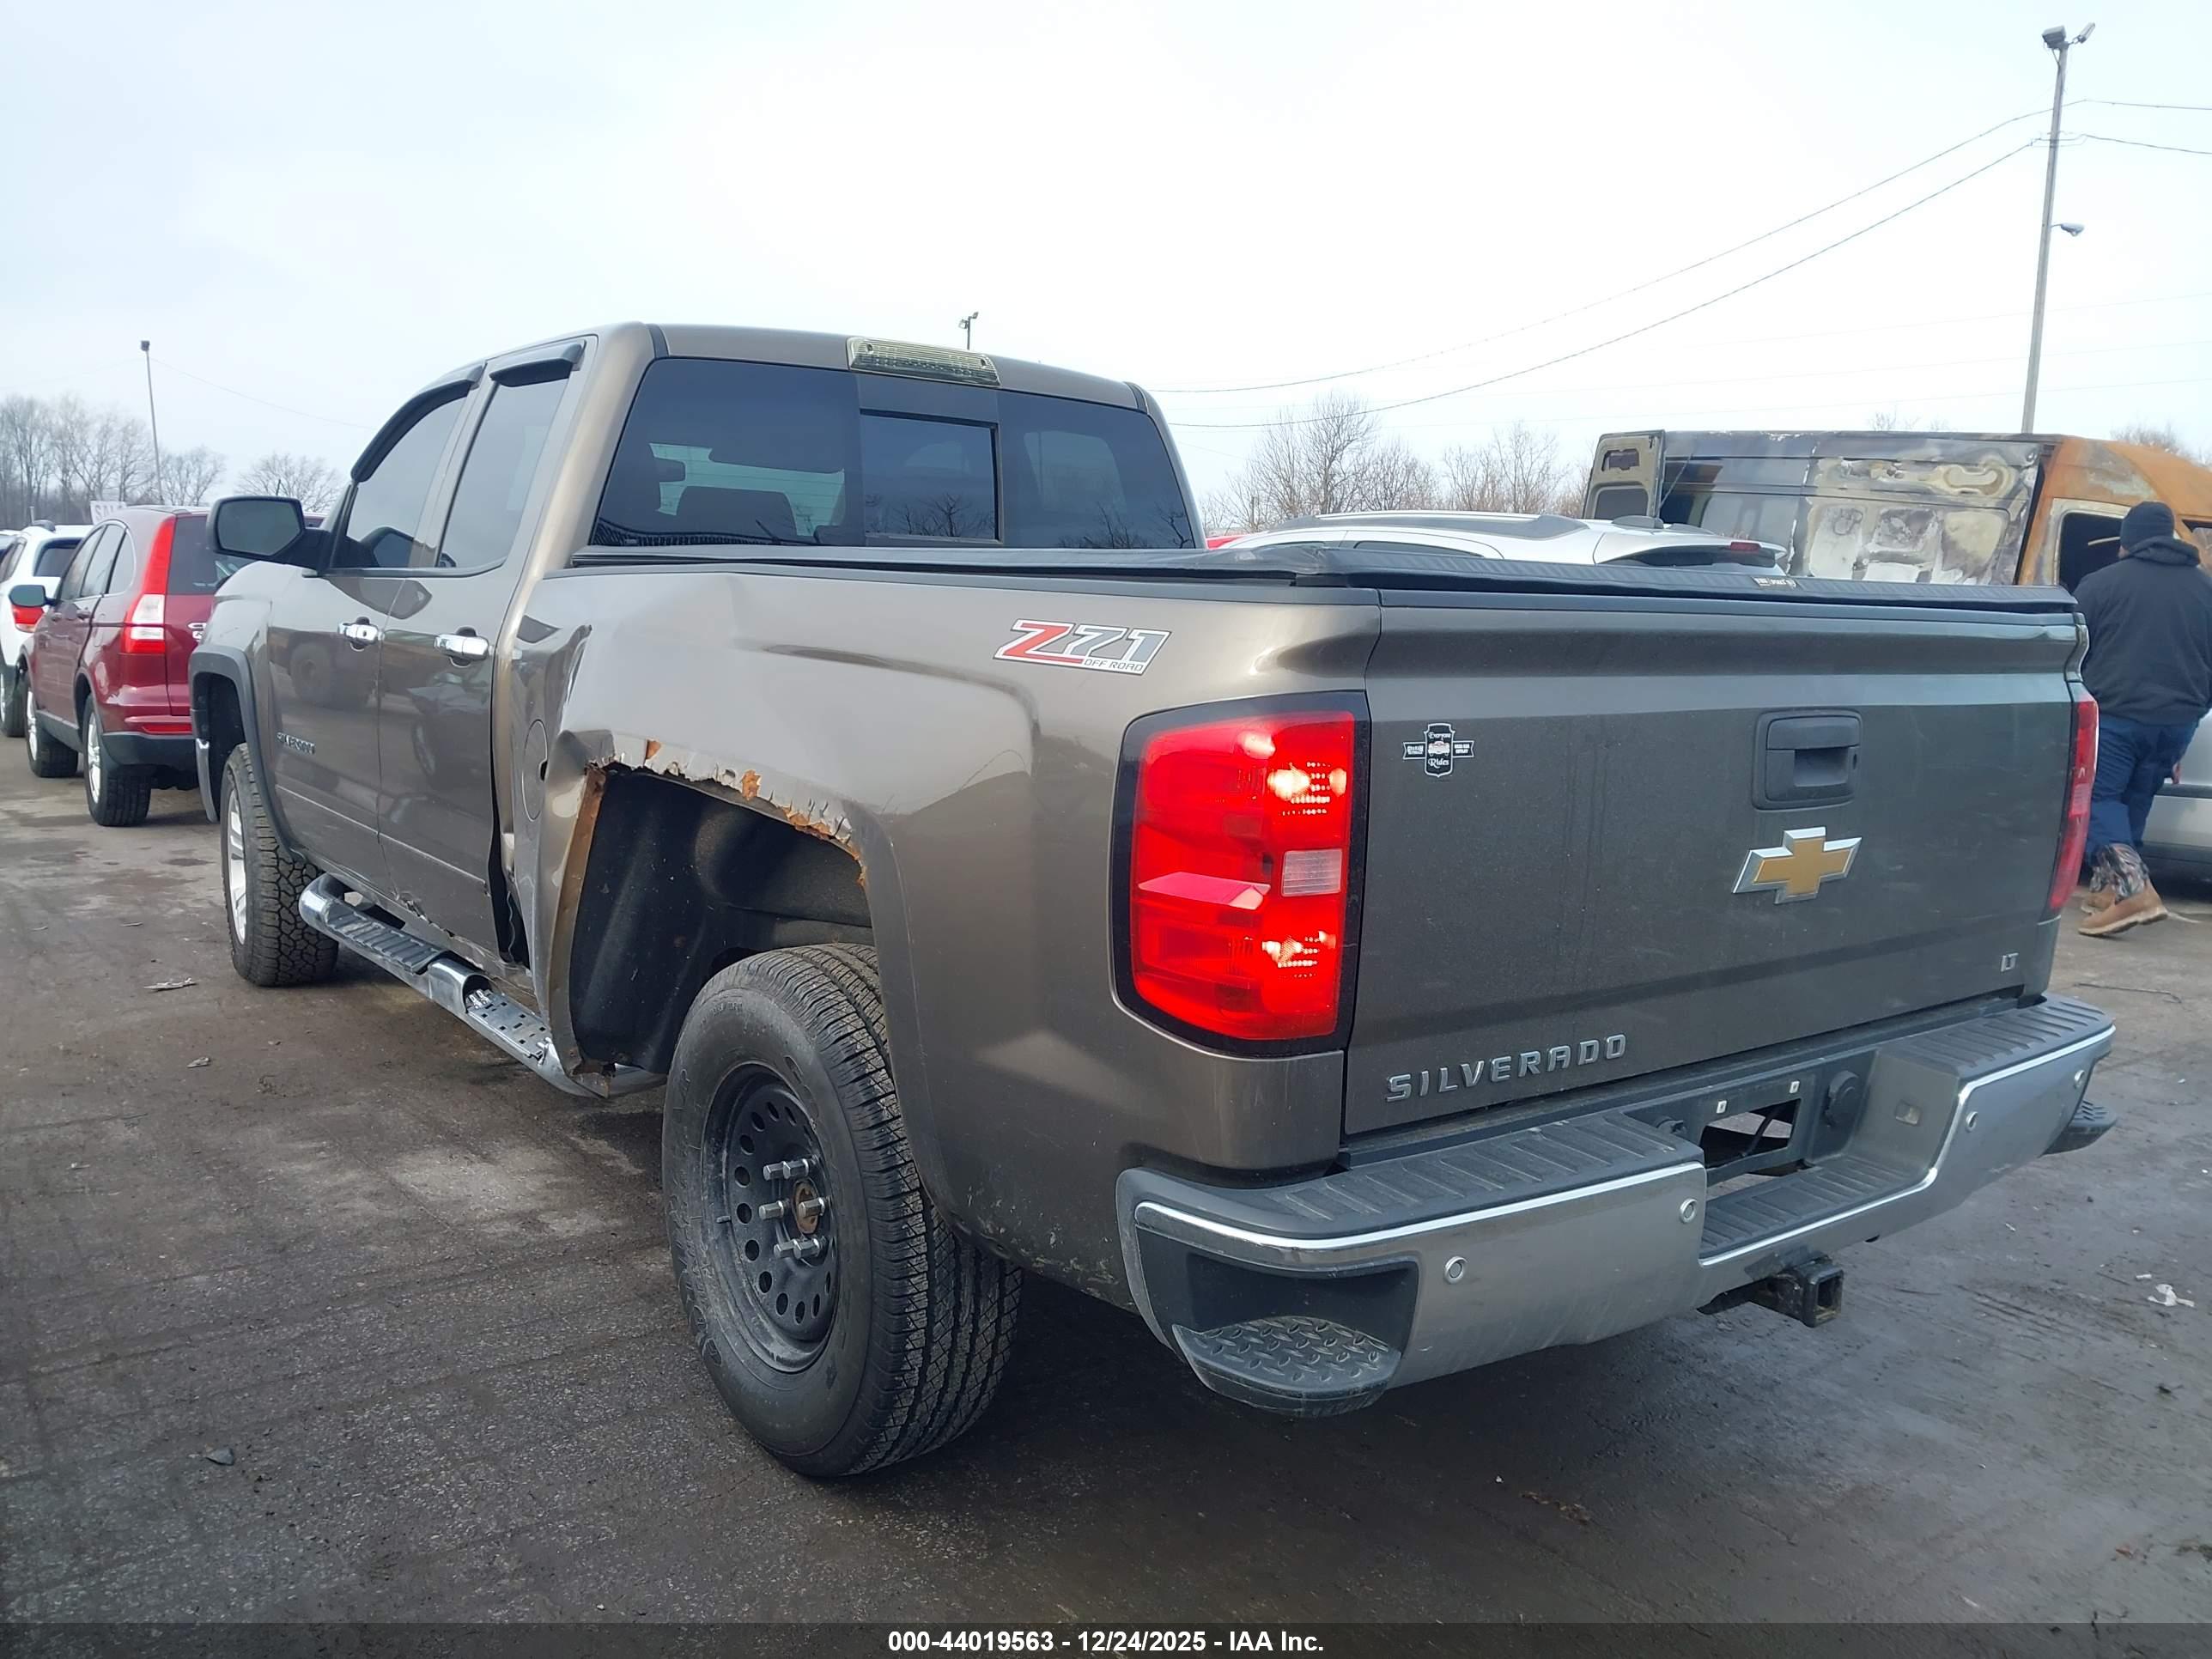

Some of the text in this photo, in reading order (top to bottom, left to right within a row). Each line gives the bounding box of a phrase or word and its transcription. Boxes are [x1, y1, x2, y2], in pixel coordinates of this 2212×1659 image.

[994, 618, 1171, 672] Z71
[1083, 659, 1144, 672] OFF ROAD
[1427, 757, 1449, 769] Rides
[1387, 1034, 1626, 1103] SILVERADO
